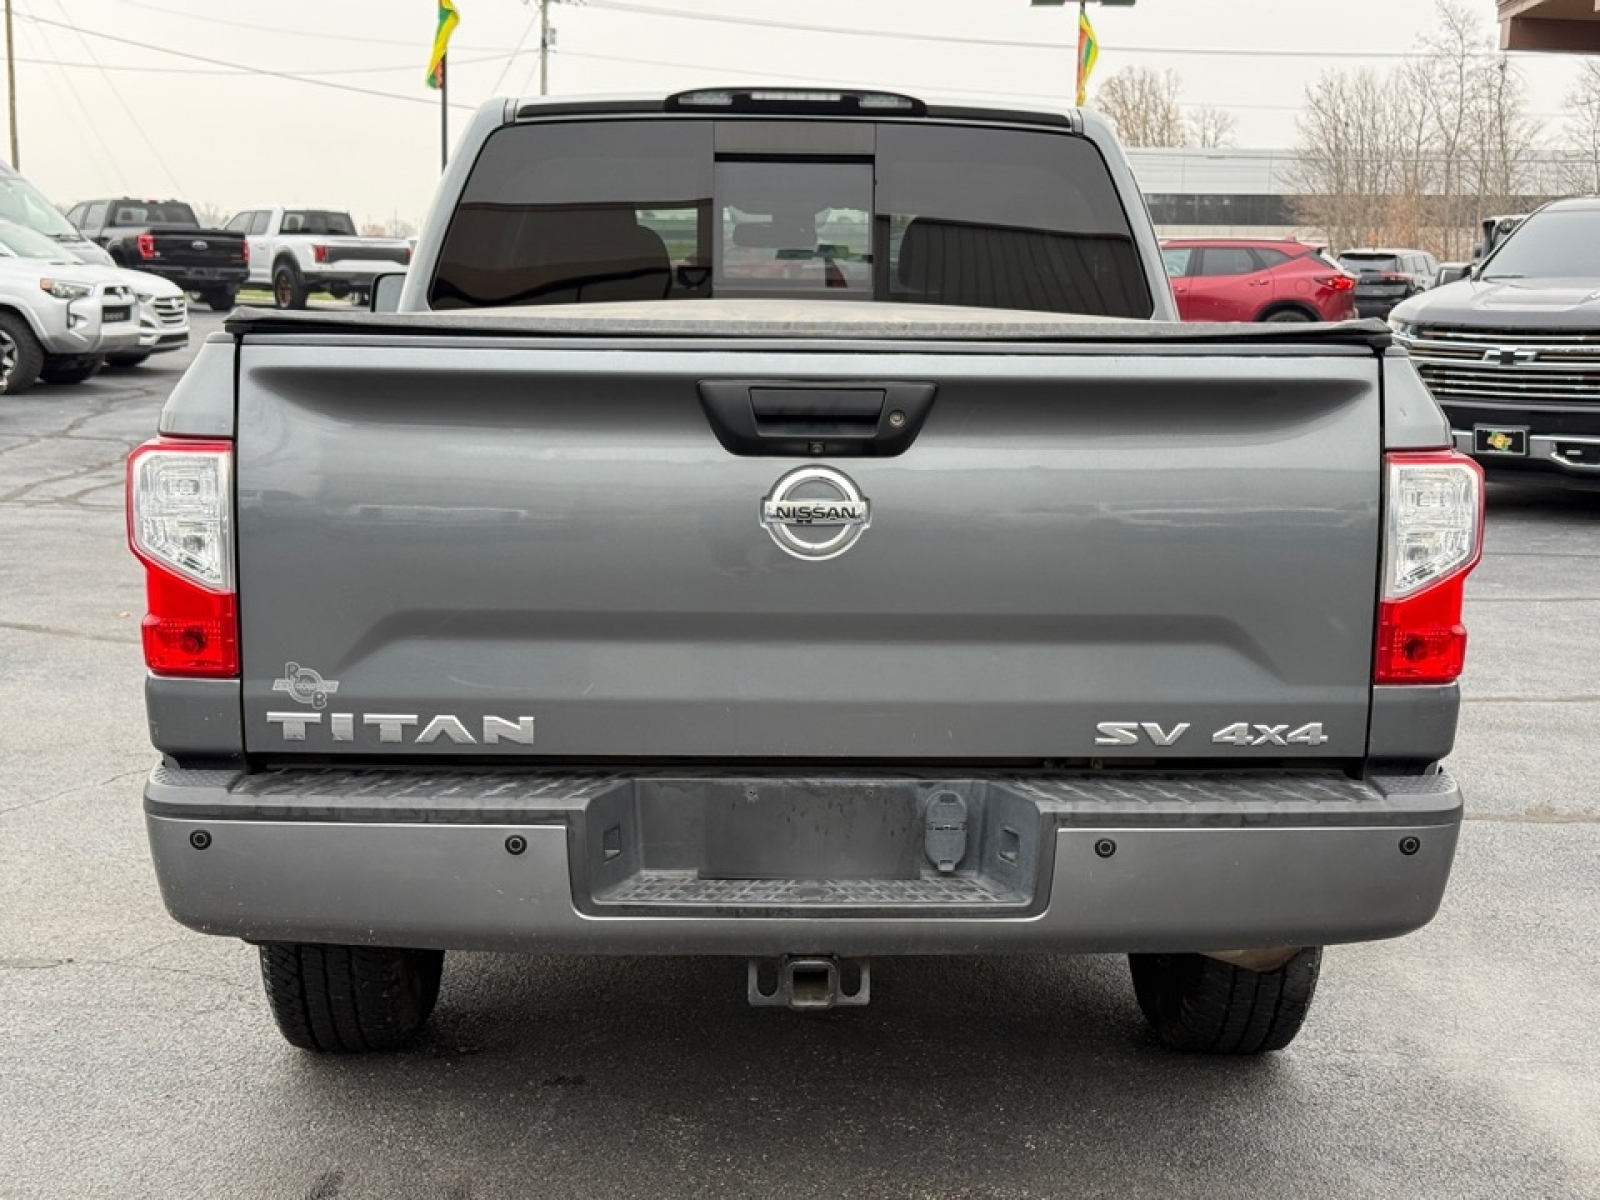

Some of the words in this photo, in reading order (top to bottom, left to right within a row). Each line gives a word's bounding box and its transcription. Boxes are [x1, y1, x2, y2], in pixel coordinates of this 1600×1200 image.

[775, 506, 856, 519] NISSAN
[266, 711, 535, 744] TITAN
[1095, 721, 1190, 746] SV
